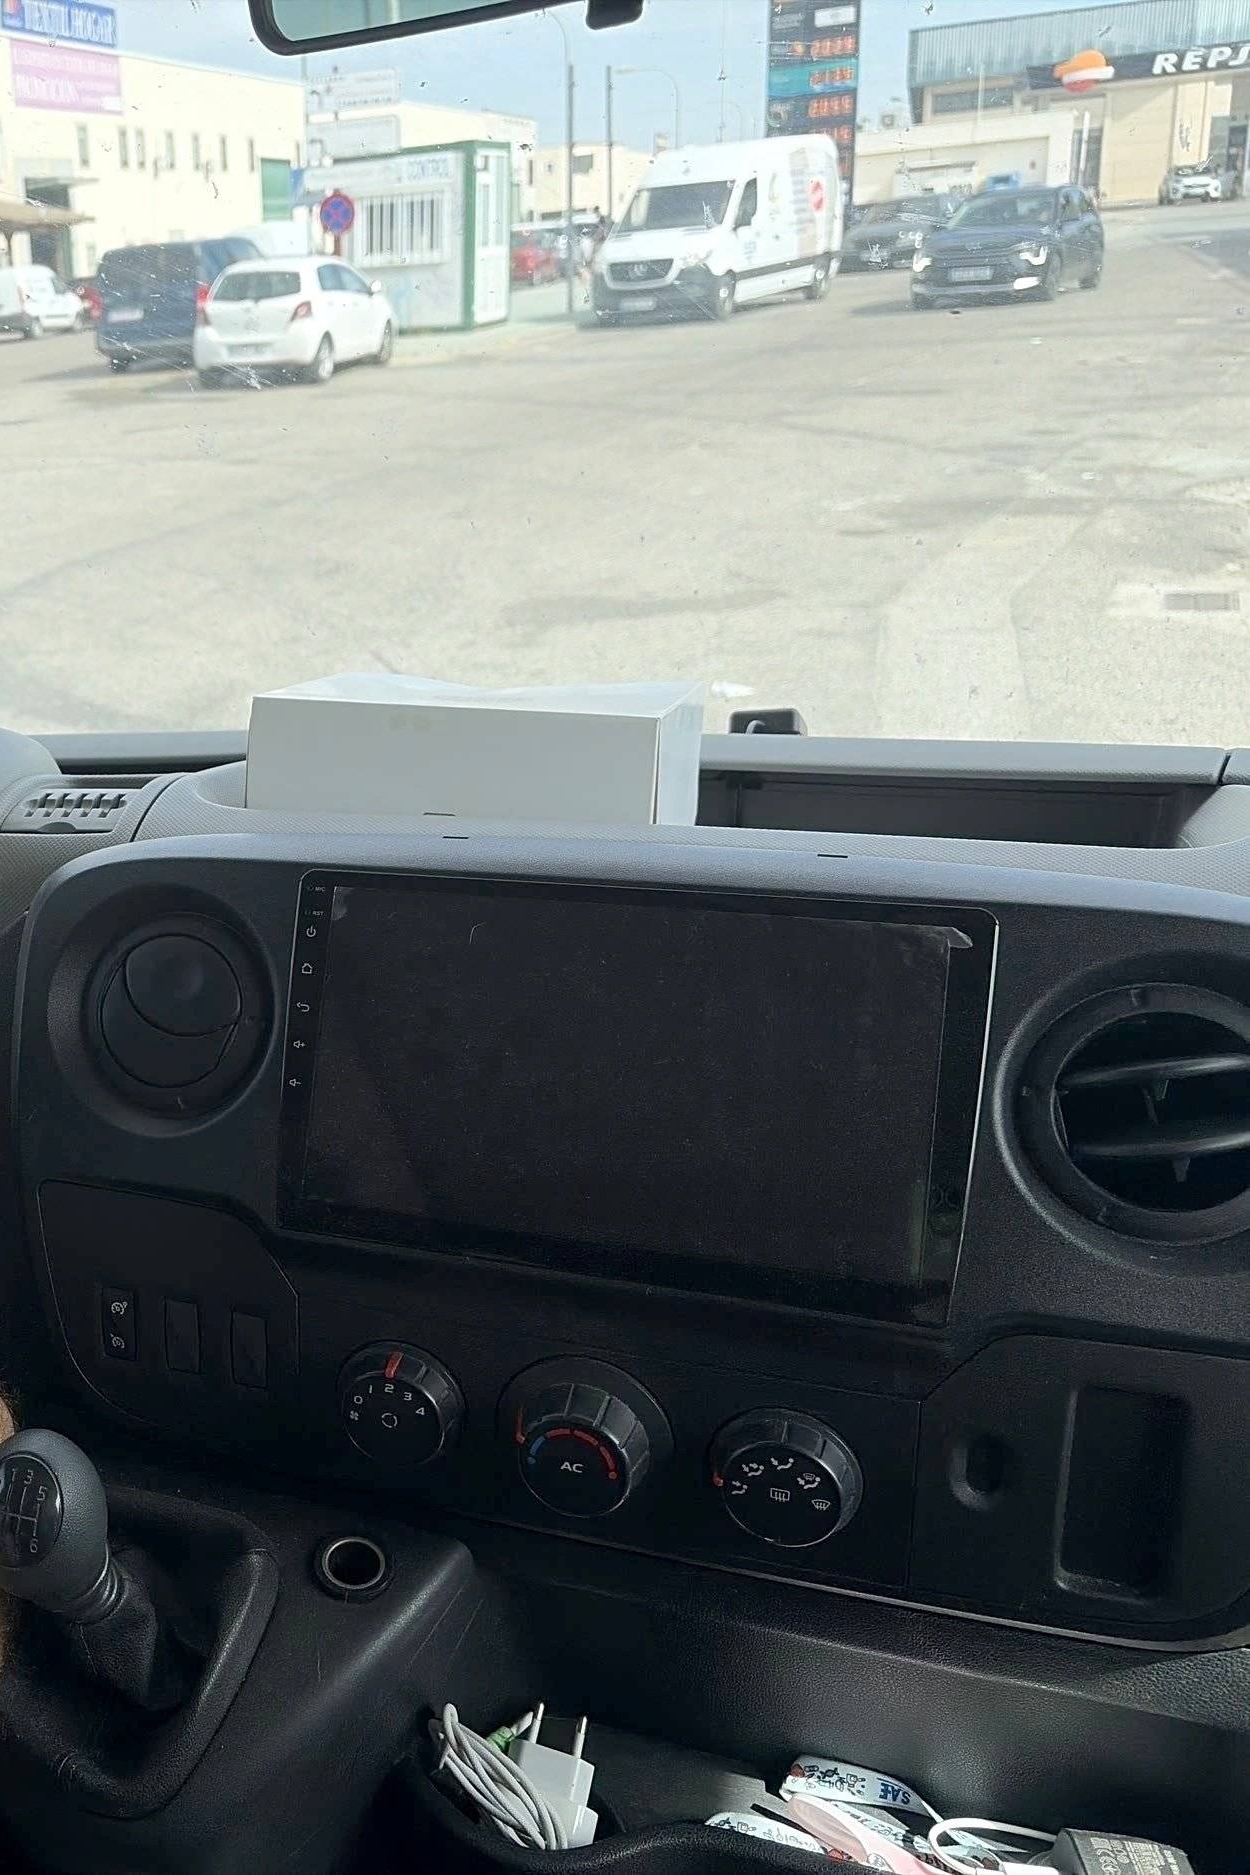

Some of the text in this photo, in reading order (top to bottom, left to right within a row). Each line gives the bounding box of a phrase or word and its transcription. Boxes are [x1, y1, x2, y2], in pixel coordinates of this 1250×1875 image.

[384, 1383, 395, 1393] 2
[403, 1391, 413, 1401] 3
[415, 1407, 426, 1416] 4
[560, 1461, 583, 1473] AC
[23, 1469, 34, 1485] 3
[36, 1485, 48, 1501] 5
[29, 1538, 39, 1553] 6
